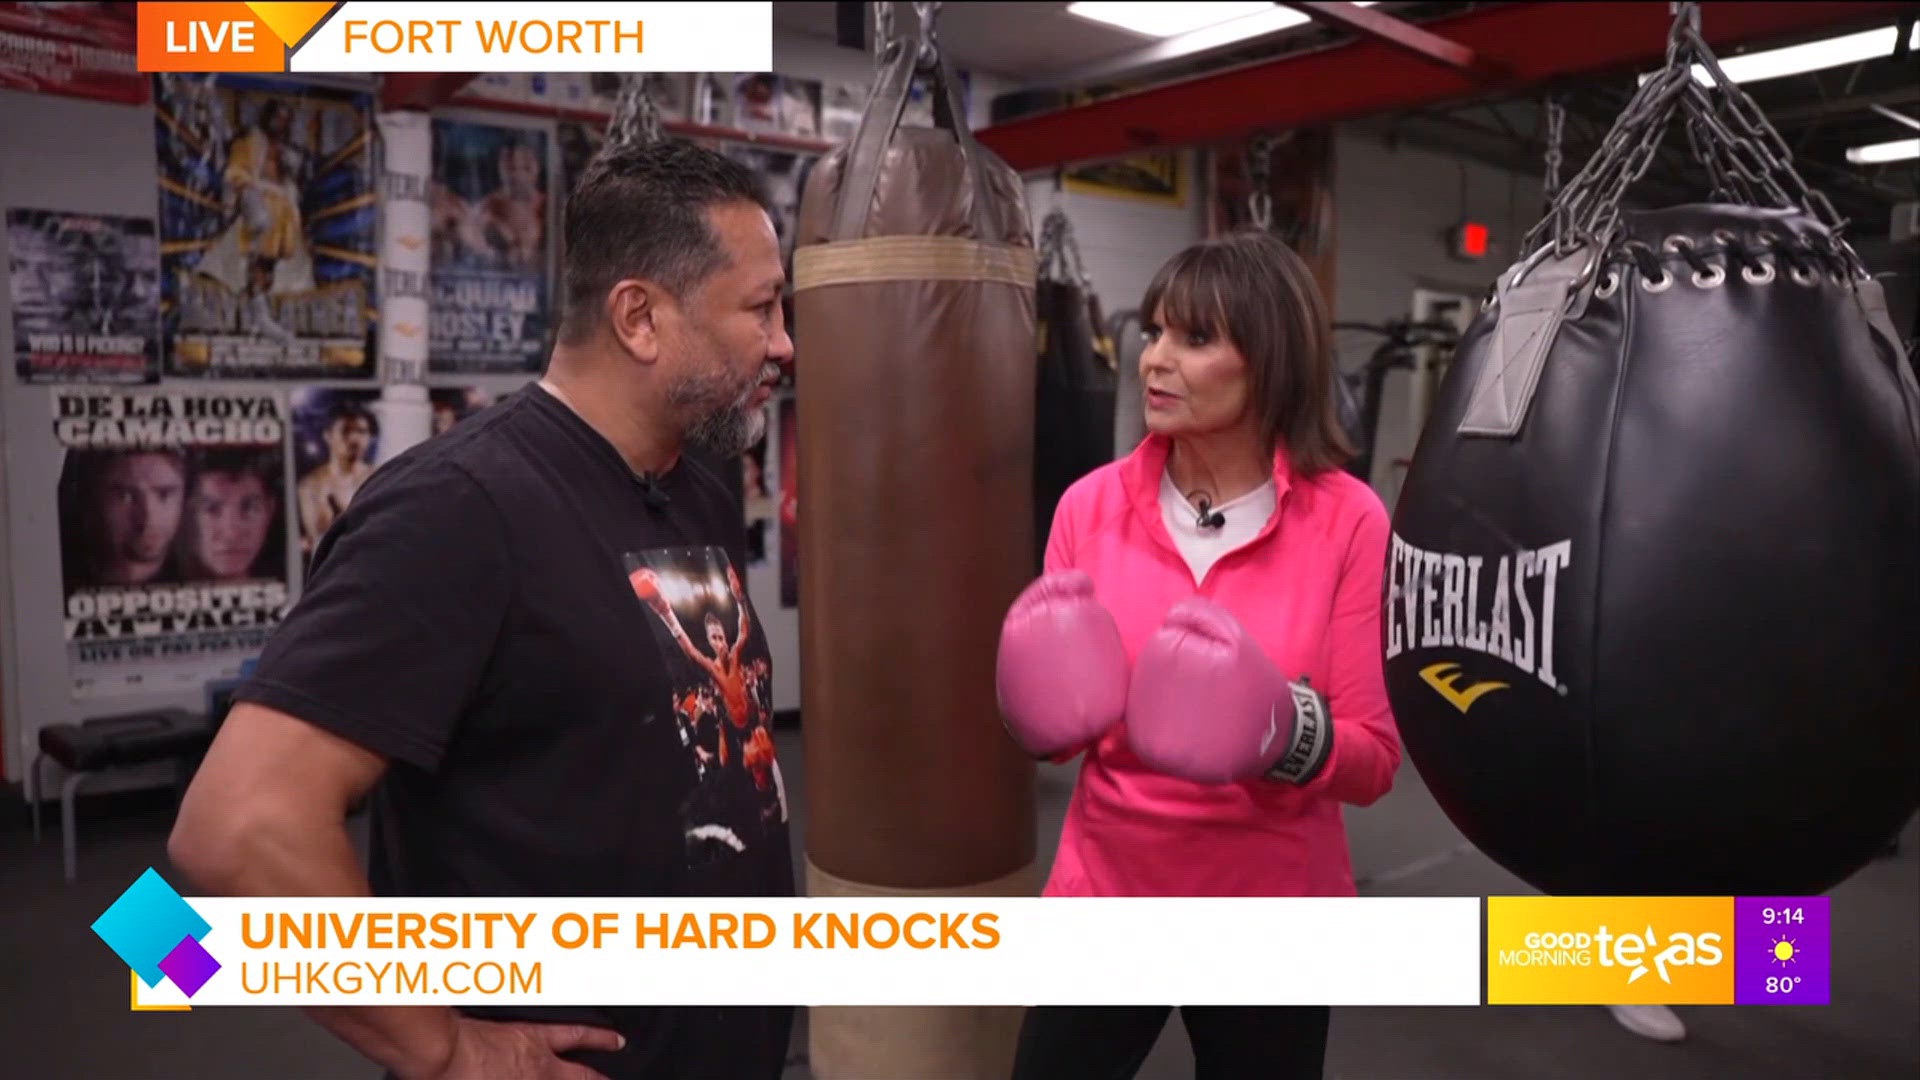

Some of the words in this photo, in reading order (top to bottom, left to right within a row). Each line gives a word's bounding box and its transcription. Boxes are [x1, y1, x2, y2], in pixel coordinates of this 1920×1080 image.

[58, 396, 113, 419] DE
[122, 396, 174, 419] LA
[183, 396, 280, 420] HOYA
[55, 418, 284, 448] CAMACHO
[67, 582, 289, 620] OPPOSITES
[1385, 530, 1572, 690] EVERLAST
[1277, 689, 1319, 777] EVERLAST
